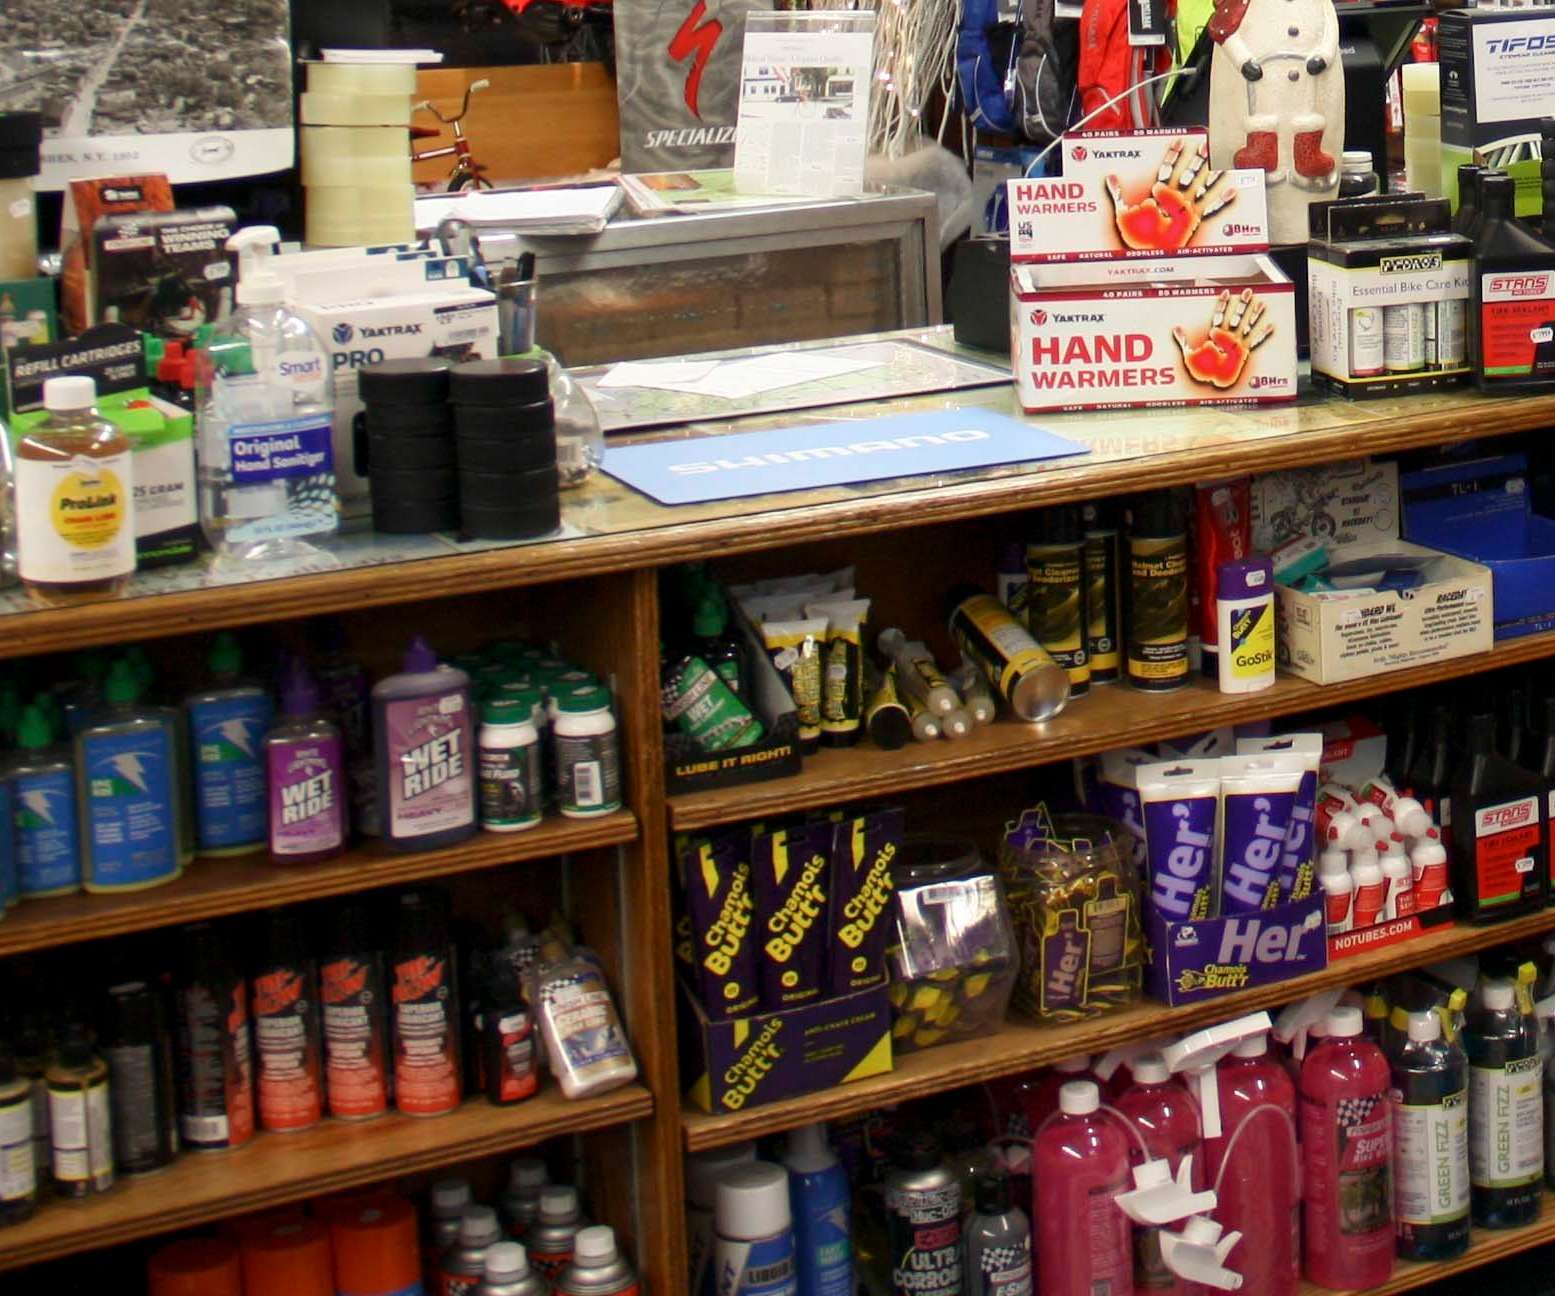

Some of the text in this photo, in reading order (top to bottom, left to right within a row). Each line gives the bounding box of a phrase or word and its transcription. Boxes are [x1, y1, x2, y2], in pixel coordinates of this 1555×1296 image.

[1096, 129, 1120, 138] PAIRS
[1146, 127, 1188, 136] WARMERS
[1093, 149, 1141, 159] YAKTRAX
[1016, 184, 1084, 201] HAND
[1017, 202, 1097, 215] WARMERS
[161, 229, 231, 244] WINNING
[180, 224, 211, 233] CHOICE
[1233, 223, 1261, 234] 8Hrs
[164, 239, 217, 254] TEAMS
[1079, 246, 1233, 259] NATURAL ODORLESS AIR-ACTIVATED
[1107, 265, 1175, 276] YAKTRAX.COM
[1381, 255, 1441, 273] PEDRO'S
[1102, 290, 1143, 299] 40 PAIRS
[1171, 287, 1216, 296] WARMERS
[1352, 277, 1471, 297] Essential Bike Care Kit
[1052, 313, 1104, 323] YAKTRAX
[359, 323, 422, 338] YAKTRAX
[15, 339, 142, 378] REFILL CARTRIDGES
[334, 348, 385, 370] PRO
[1032, 334, 1153, 366] HAND
[279, 357, 321, 376] Smart
[1031, 367, 1176, 390] WARMERS
[1260, 375, 1289, 386] 8Hrs
[234, 435, 300, 459] Original
[668, 429, 991, 475] SHIMANO
[234, 451, 325, 473] Hand Sanitizer
[149, 481, 184, 495] GRAM
[60, 493, 117, 511] ProLink
[402, 727, 462, 774] WET
[676, 745, 792, 776] LUBE IT RIGHT!
[281, 769, 333, 805] WET
[404, 757, 463, 800] RIDE
[282, 792, 334, 825] RIDE
[843, 842, 896, 918] Chamois
[768, 854, 825, 932] Chamois
[704, 861, 749, 947] Chamois
[1335, 919, 1413, 950] NOTUBES.COM
[1203, 963, 1247, 975] Chamois
[1204, 973, 1249, 989] Butt'r
[724, 1017, 783, 1084] Chamois
[1497, 1084, 1510, 1174] GREEN FIZZ
[1436, 1119, 1451, 1209] GREEN FIZZ
